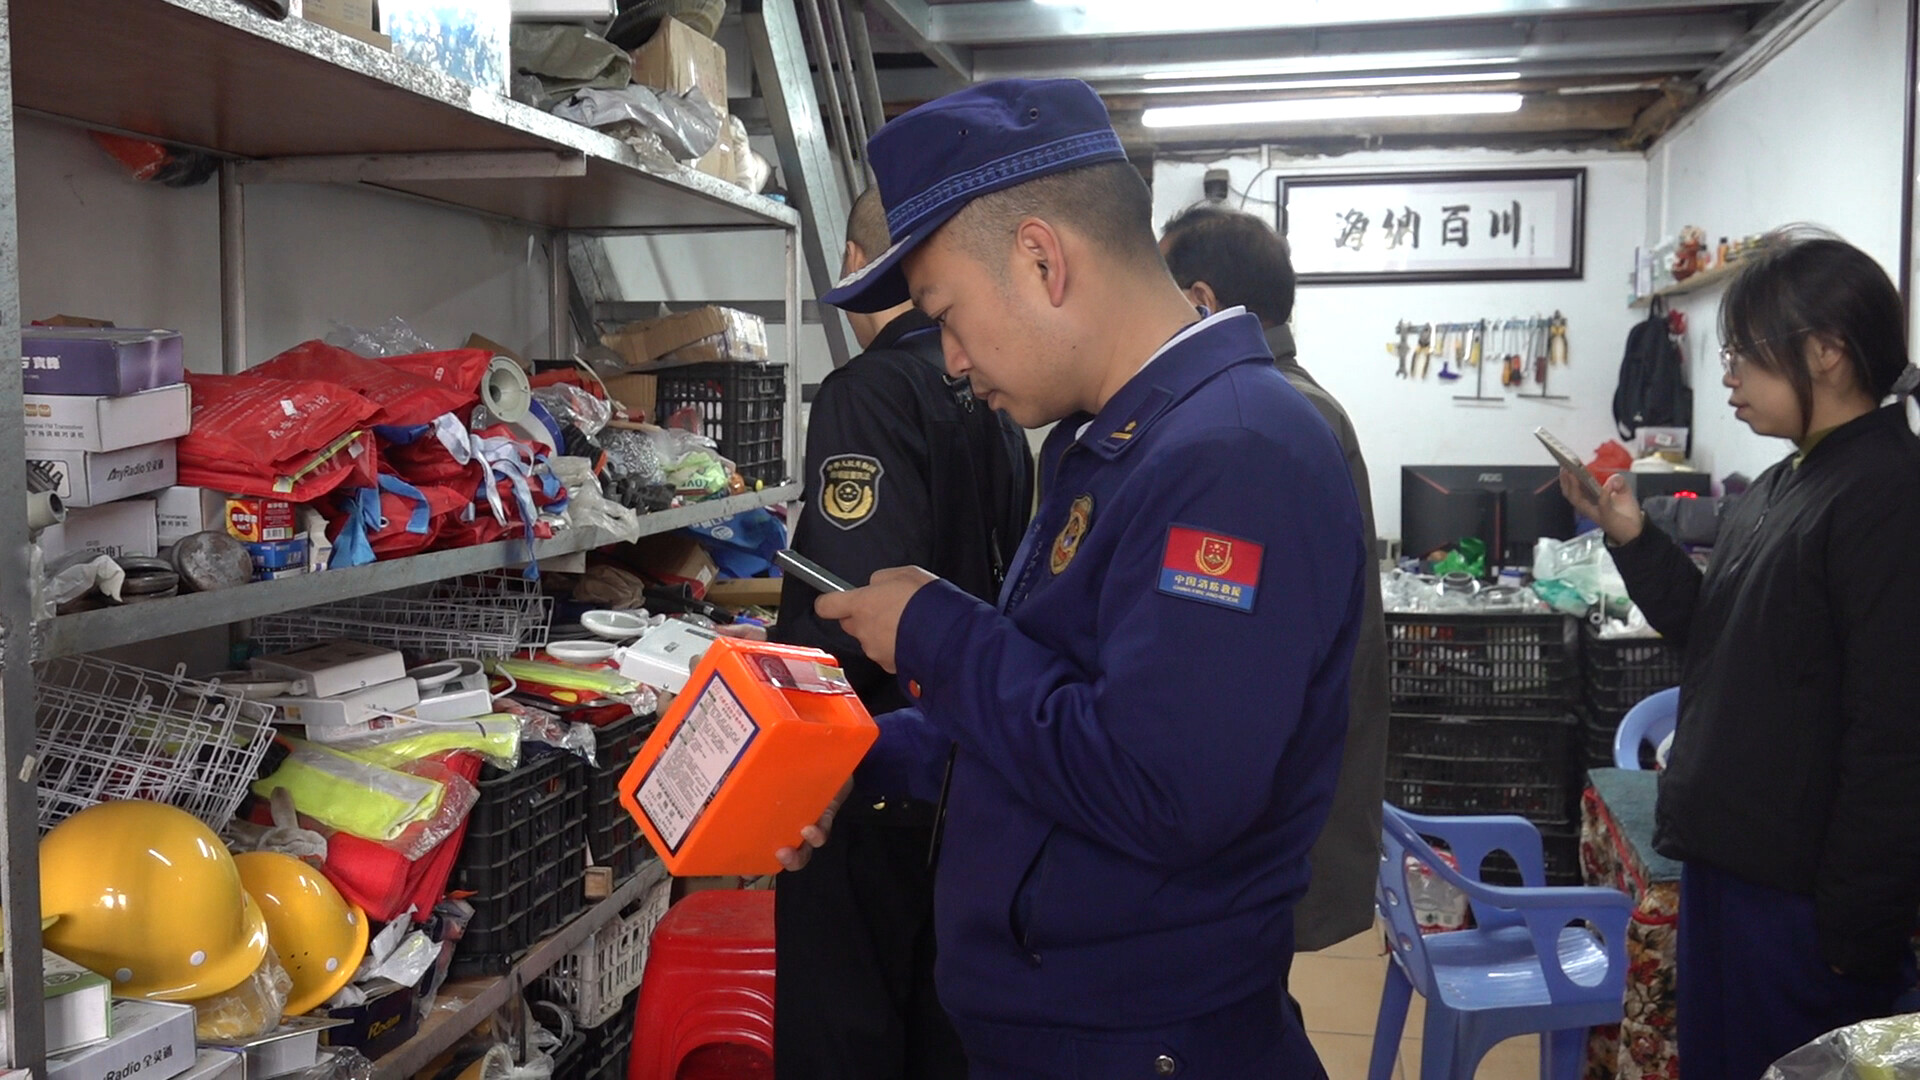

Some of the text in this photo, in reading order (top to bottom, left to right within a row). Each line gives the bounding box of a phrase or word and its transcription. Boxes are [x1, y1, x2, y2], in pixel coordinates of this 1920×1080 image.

[1173, 574, 1242, 597] 中国消防救援
